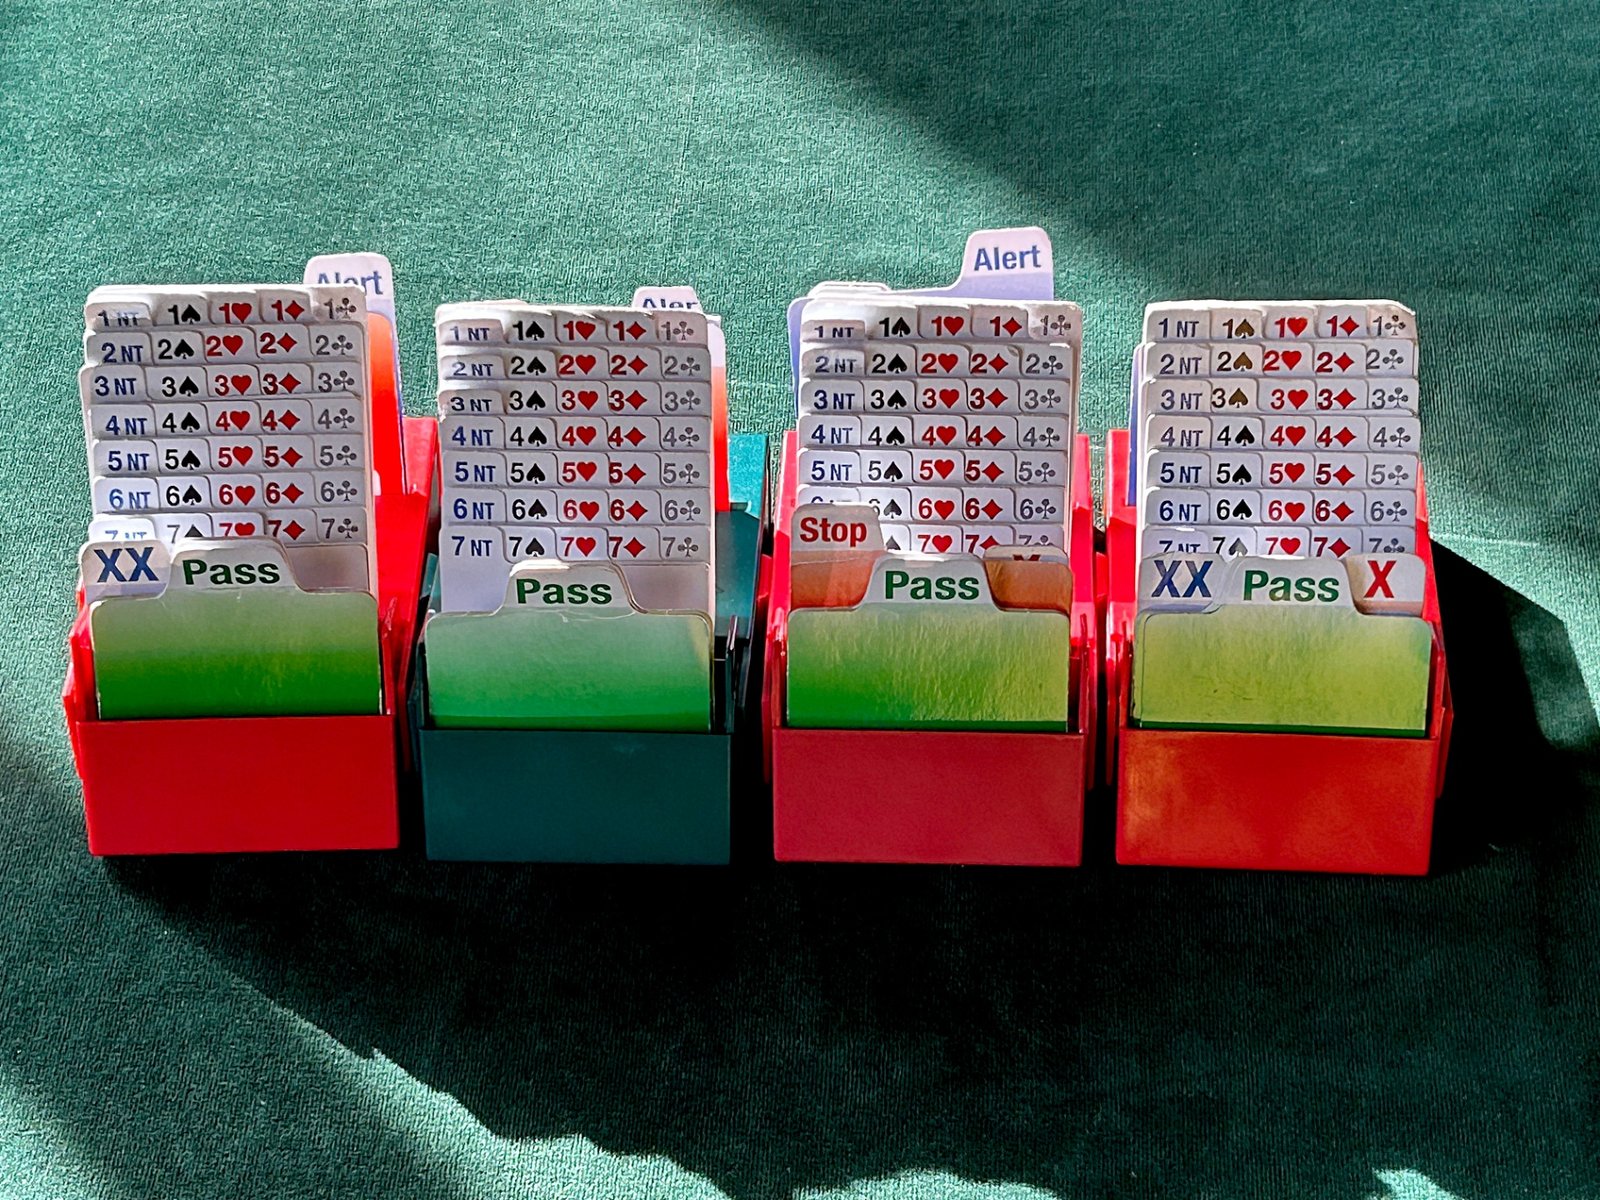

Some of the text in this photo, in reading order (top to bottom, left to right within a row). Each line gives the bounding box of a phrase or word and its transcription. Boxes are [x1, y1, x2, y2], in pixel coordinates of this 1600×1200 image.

[974, 245, 1041, 271] Alert
[800, 517, 866, 547] Stop
[94, 547, 159, 582] XX
[182, 559, 280, 585] Pass
[1152, 560, 1214, 598] XX
[1364, 560, 1396, 598] X
[516, 579, 612, 604] Pass
[886, 570, 979, 600] Pass
[1244, 570, 1340, 602] Pass
